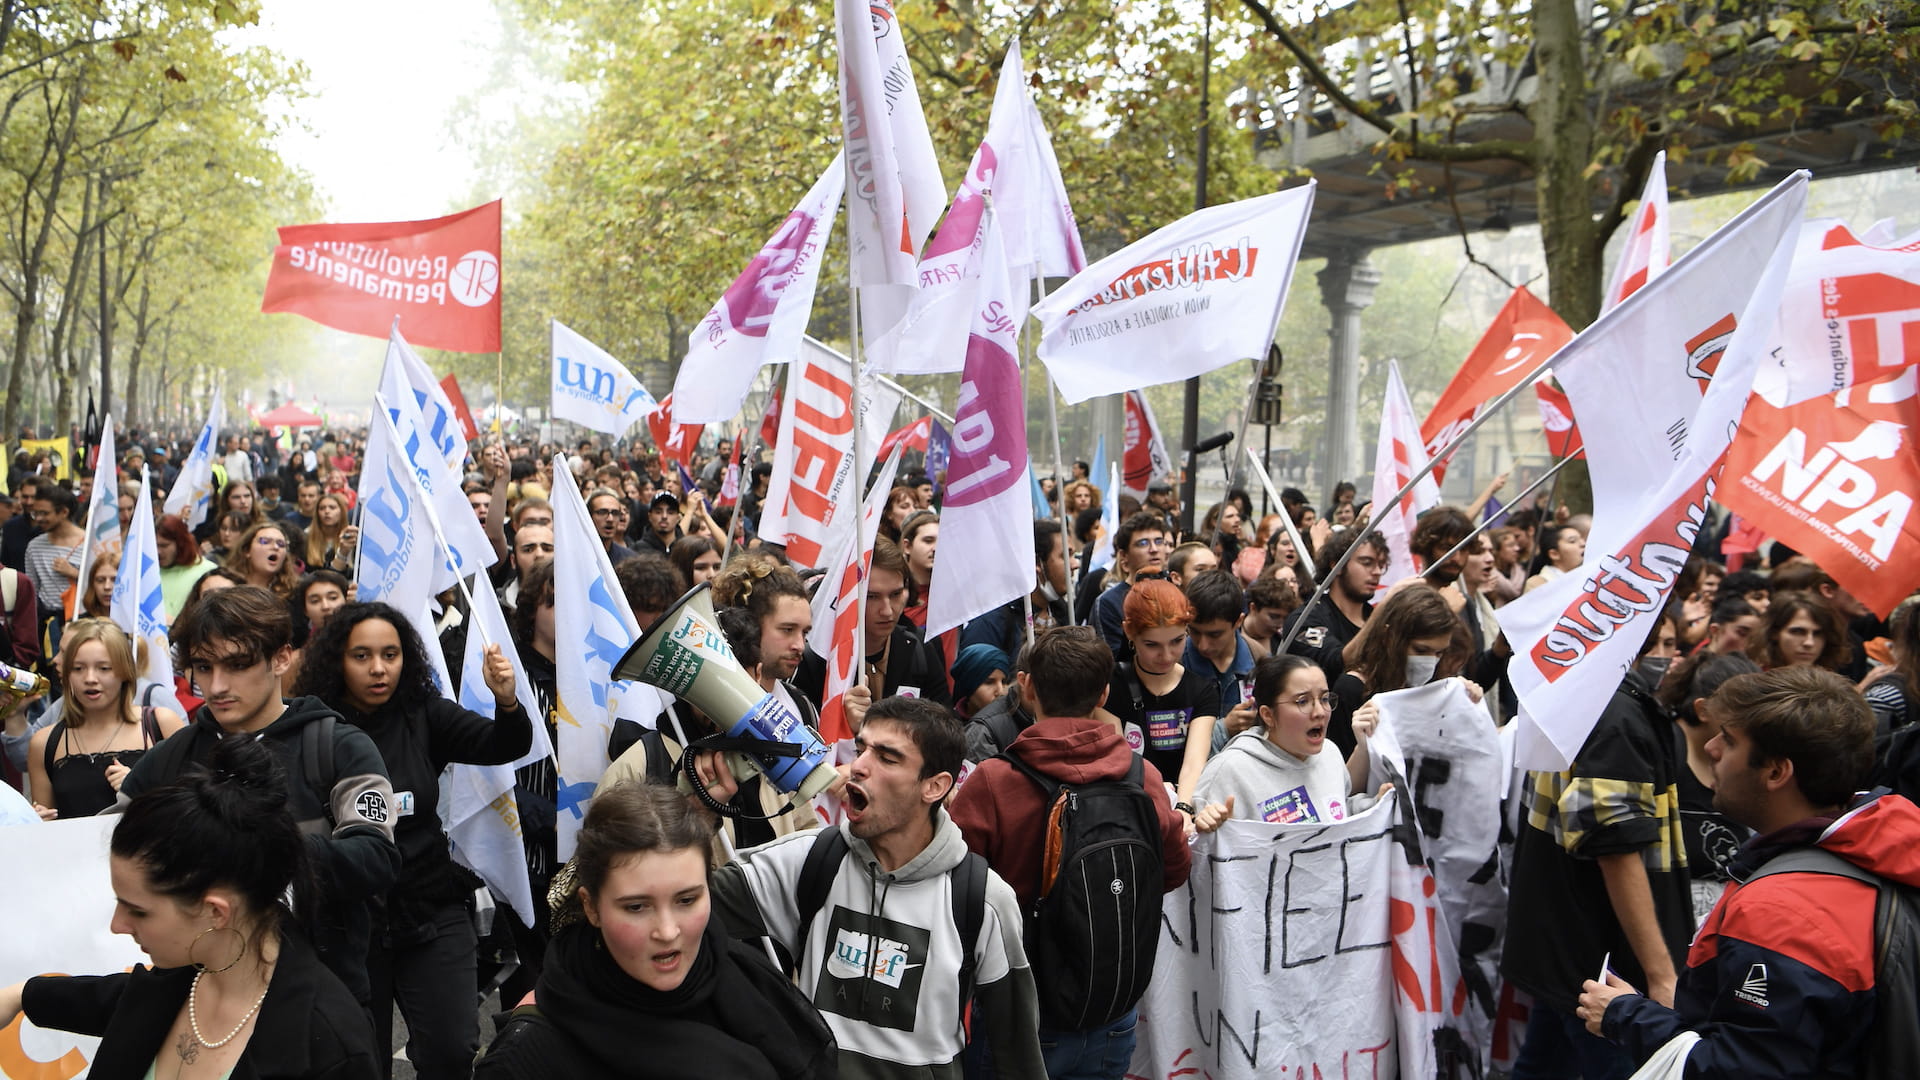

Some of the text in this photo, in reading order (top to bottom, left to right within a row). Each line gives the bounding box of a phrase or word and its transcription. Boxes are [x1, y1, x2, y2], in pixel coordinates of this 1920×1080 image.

[1740, 475, 1881, 572] NOUVEAU PARTI ANTICAPITALISTE
[1751, 427, 1912, 562] NPA
[669, 645, 684, 667] POUR
